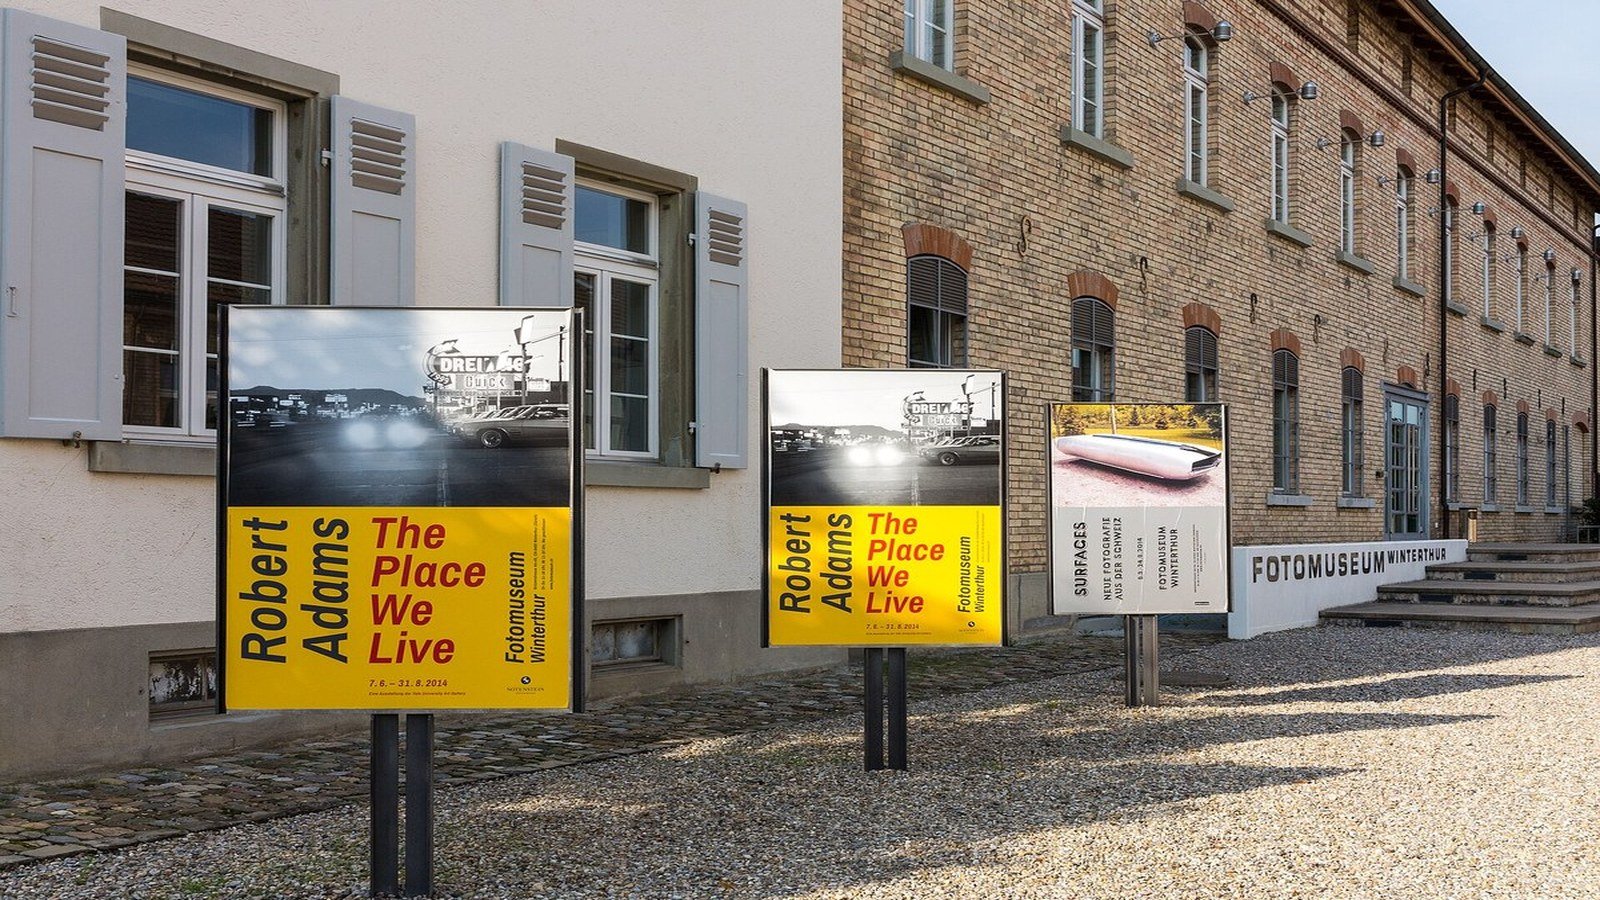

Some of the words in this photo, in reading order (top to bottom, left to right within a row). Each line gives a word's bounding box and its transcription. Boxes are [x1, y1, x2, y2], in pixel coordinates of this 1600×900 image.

[371, 516, 446, 549] The
[867, 512, 918, 535] The
[1113, 517, 1122, 559] SCHWEIZ
[779, 513, 811, 613] Robert
[820, 513, 852, 613] Adams
[867, 539, 945, 561] Place
[1073, 522, 1087, 596] SURFACES
[1102, 517, 1111, 573] FOTOGRAFIE
[1158, 526, 1167, 590] FOTOMUSEUM
[1170, 529, 1178, 588] WINTERTHUR
[1253, 551, 1385, 583] FOTOMUSEUM
[1387, 548, 1446, 564] WINTERTHUR
[239, 516, 287, 663] Robert
[300, 517, 349, 664] Adams
[371, 555, 486, 588] Place
[867, 566, 909, 587] We
[958, 536, 971, 613] Fotomuseum
[974, 566, 985, 613] Winterthur
[1103, 577, 1112, 600] NEUE
[1114, 561, 1123, 580] DER
[1114, 583, 1123, 600] AUS
[371, 594, 433, 626] We
[505, 551, 525, 664] Fotomuseum
[866, 591, 924, 613] Live
[369, 631, 455, 664] Live
[530, 593, 546, 664] Winterthur
